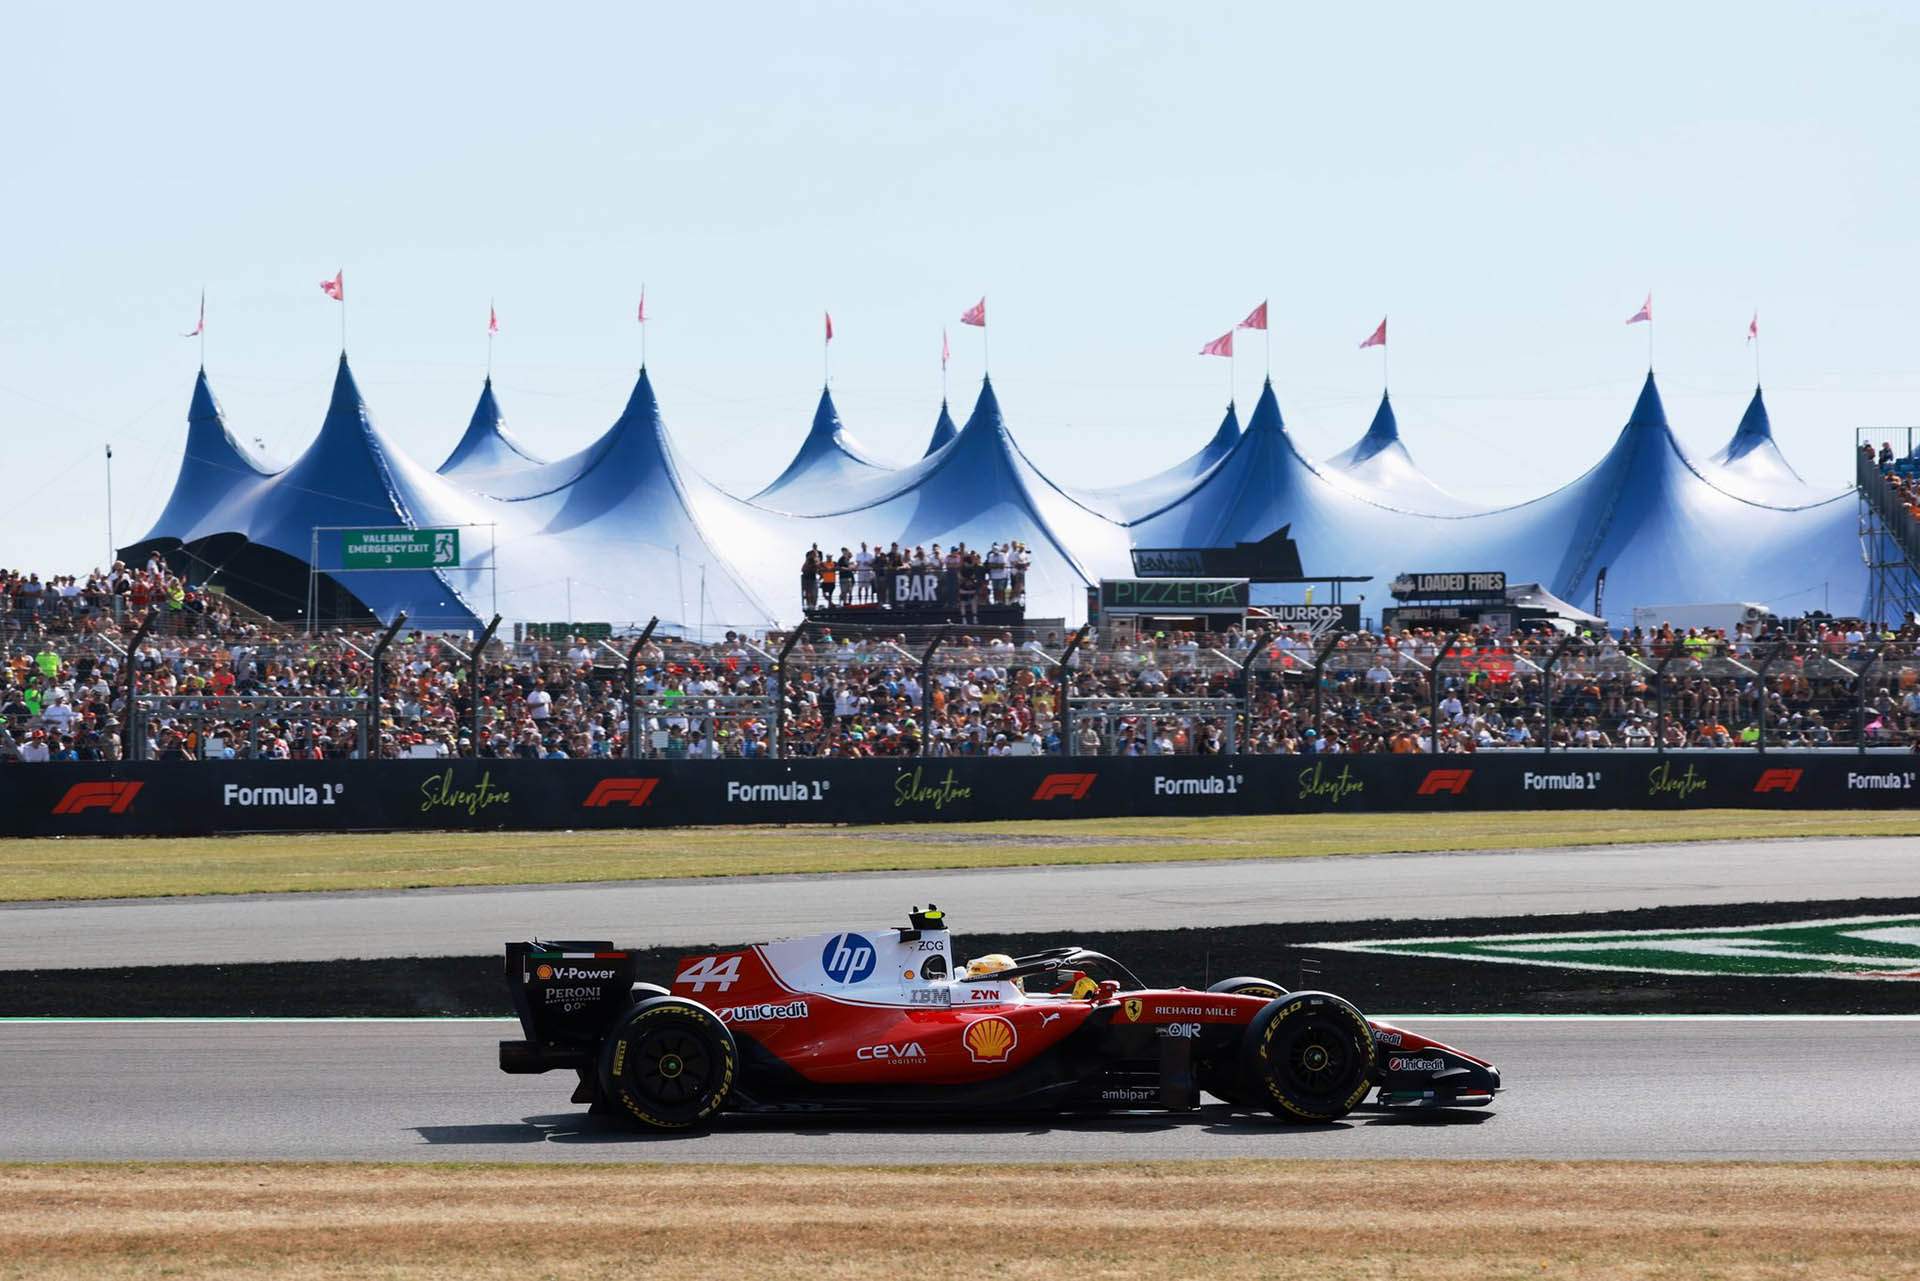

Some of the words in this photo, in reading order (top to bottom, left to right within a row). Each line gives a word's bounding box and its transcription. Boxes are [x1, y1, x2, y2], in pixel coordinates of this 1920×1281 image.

[362, 534, 385, 543] VALE
[388, 534, 414, 543] BANK
[348, 544, 406, 554] EMERGENCY
[408, 544, 429, 552] EXIT
[385, 555, 392, 563] 3
[895, 575, 938, 601] BAR
[1418, 575, 1464, 591] LOADED
[1468, 574, 1503, 590] FRIES
[1115, 582, 1238, 604] PIZZERIA
[895, 766, 972, 810] Silverstone
[1032, 773, 1097, 800] F1
[1155, 775, 1224, 795] Formula
[1299, 761, 1364, 802] Silverstone
[1416, 769, 1475, 794] F1
[1524, 771, 1584, 790] Formula
[1753, 768, 1804, 792] F1
[1848, 772, 1901, 789] Formula
[52, 781, 144, 814] F1
[224, 783, 317, 806] Formula
[420, 768, 511, 815] Silverstone
[582, 778, 660, 807] F1
[727, 781, 808, 802] Formula
[918, 940, 944, 951] ZCG
[825, 933, 874, 984] hp
[553, 967, 616, 979] V-Power
[675, 956, 743, 992] 44
[545, 987, 601, 999] PERONI
[910, 989, 950, 1003] IBM
[971, 990, 1000, 1000] ZYN
[732, 1002, 808, 1020] UniCredit
[1155, 1006, 1201, 1015] RICHARD
[1205, 1007, 1237, 1017] MILLE
[1264, 1000, 1302, 1042] ZERO
[1373, 1029, 1402, 1046] Credit
[1401, 1058, 1444, 1070] UniCredit
[1102, 1089, 1149, 1101] ambipar
